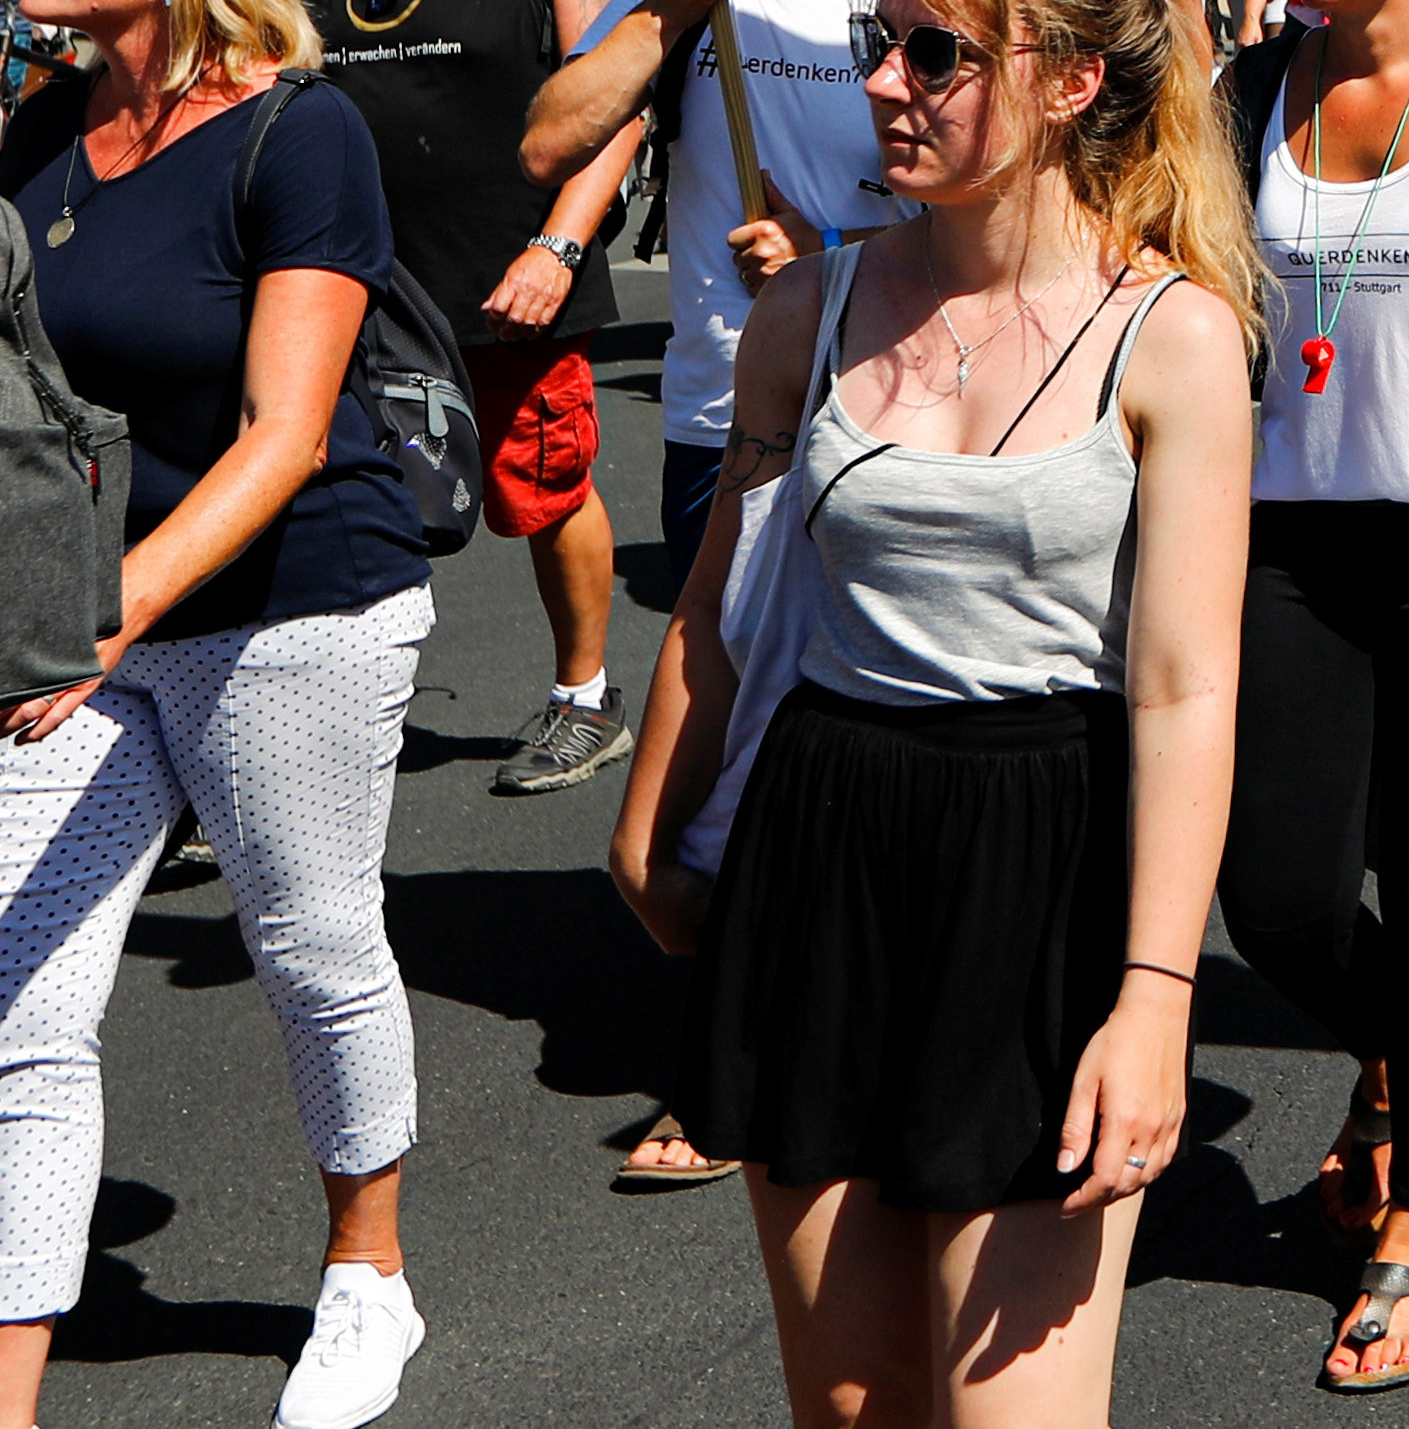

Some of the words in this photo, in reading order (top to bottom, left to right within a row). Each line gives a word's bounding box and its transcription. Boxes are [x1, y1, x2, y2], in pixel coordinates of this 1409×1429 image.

[348, 44, 398, 63] erwachen
[404, 37, 462, 58] verändern
[1353, 281, 1402, 295] Stuttgart
